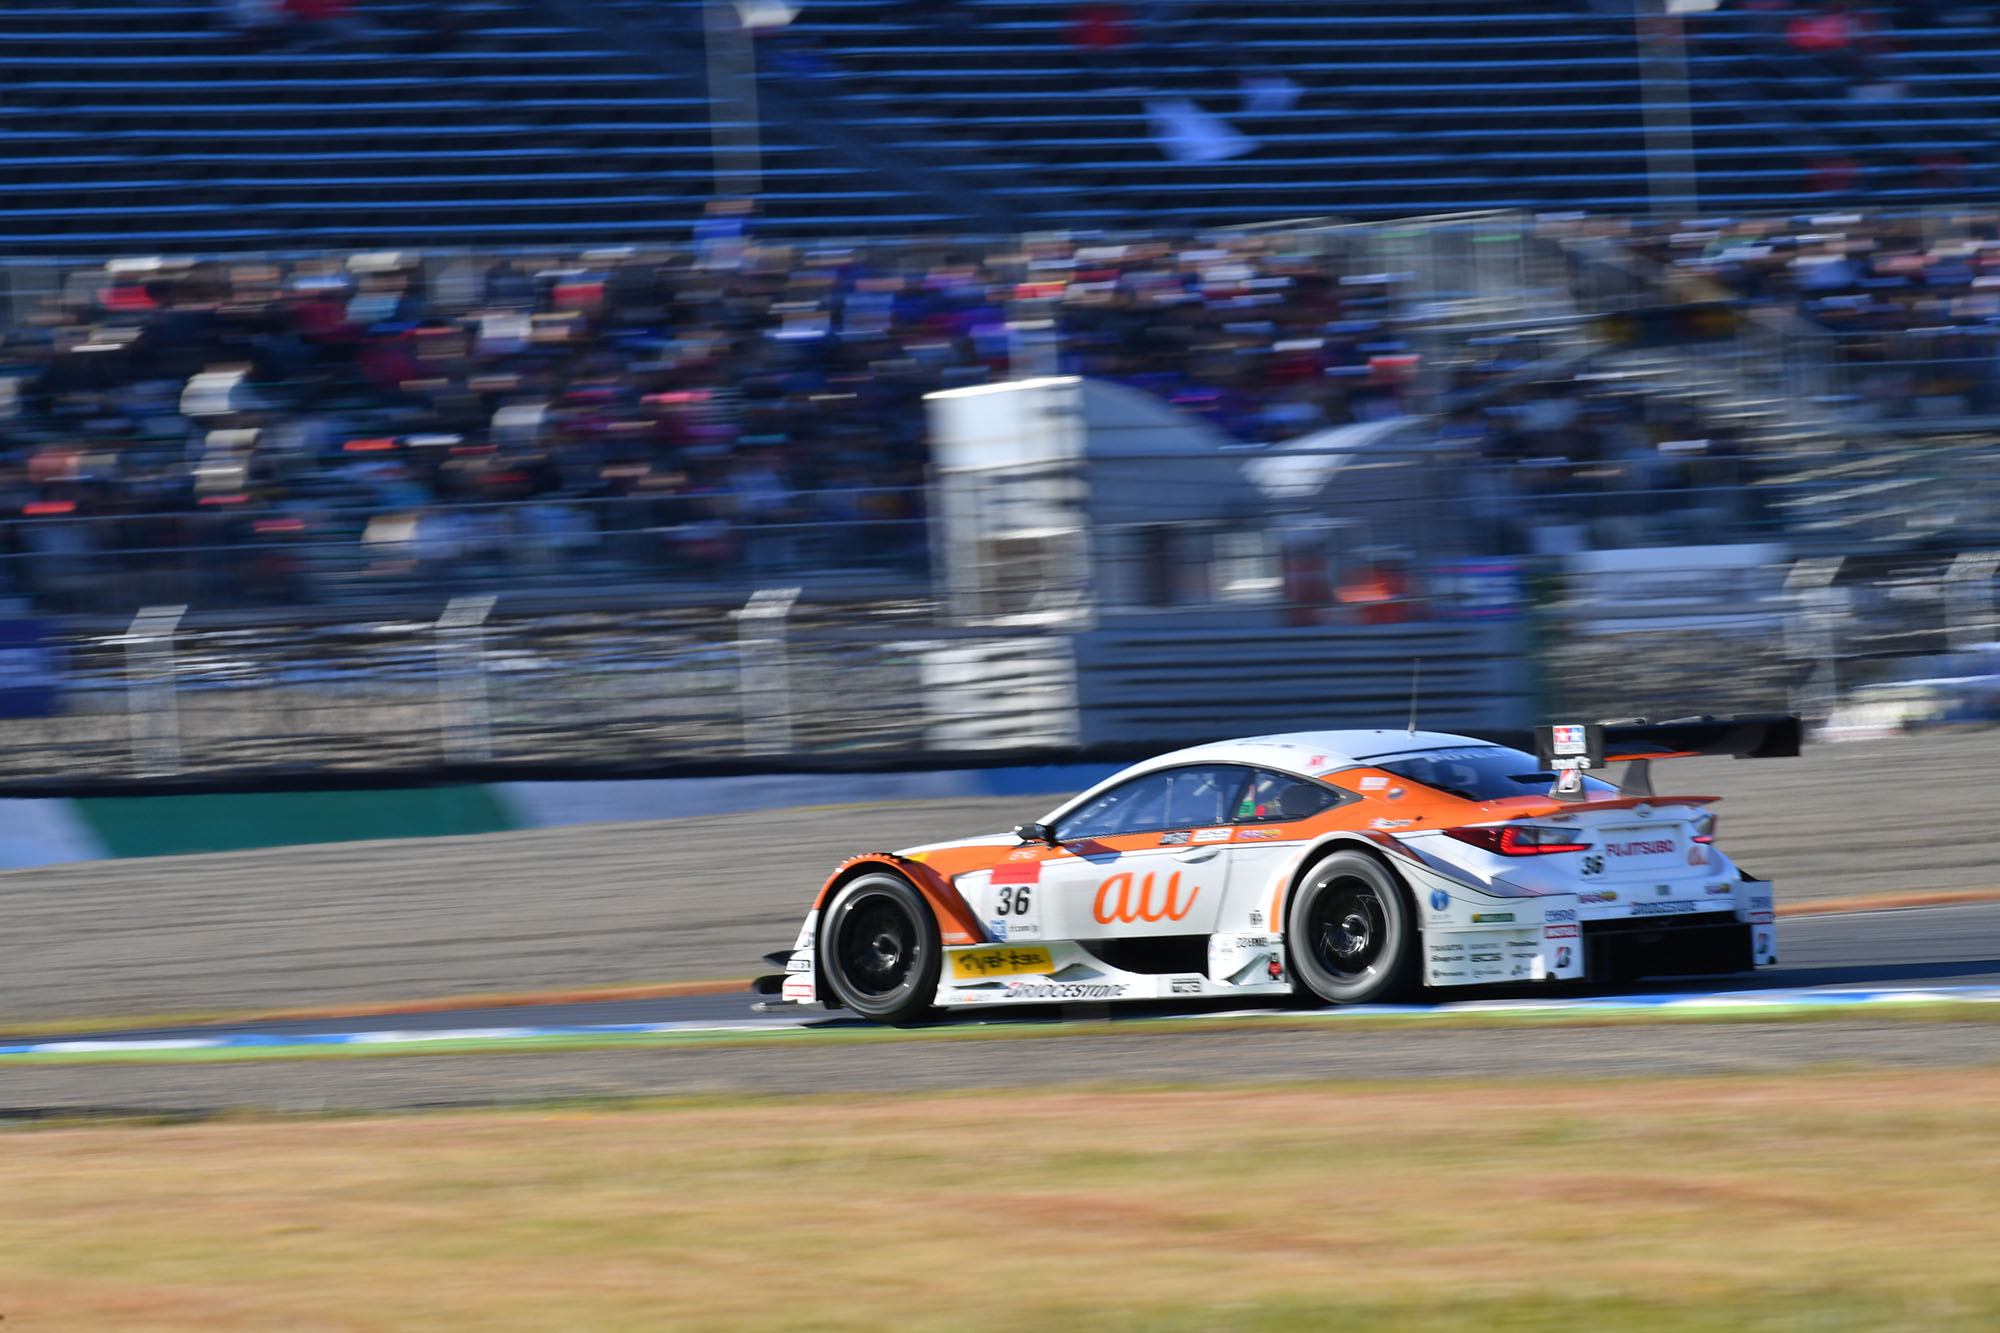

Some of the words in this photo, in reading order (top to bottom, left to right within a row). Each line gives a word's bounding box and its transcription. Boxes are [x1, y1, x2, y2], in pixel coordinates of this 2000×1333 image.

[1606, 839, 1674, 857] FUJITSUBO
[1579, 855, 1605, 875] 36
[996, 886, 1031, 916] 36
[1093, 870, 1200, 925] au
[1630, 900, 1697, 916] BRIDGESTONE
[1004, 982, 1131, 998] BRIDGESTONE
